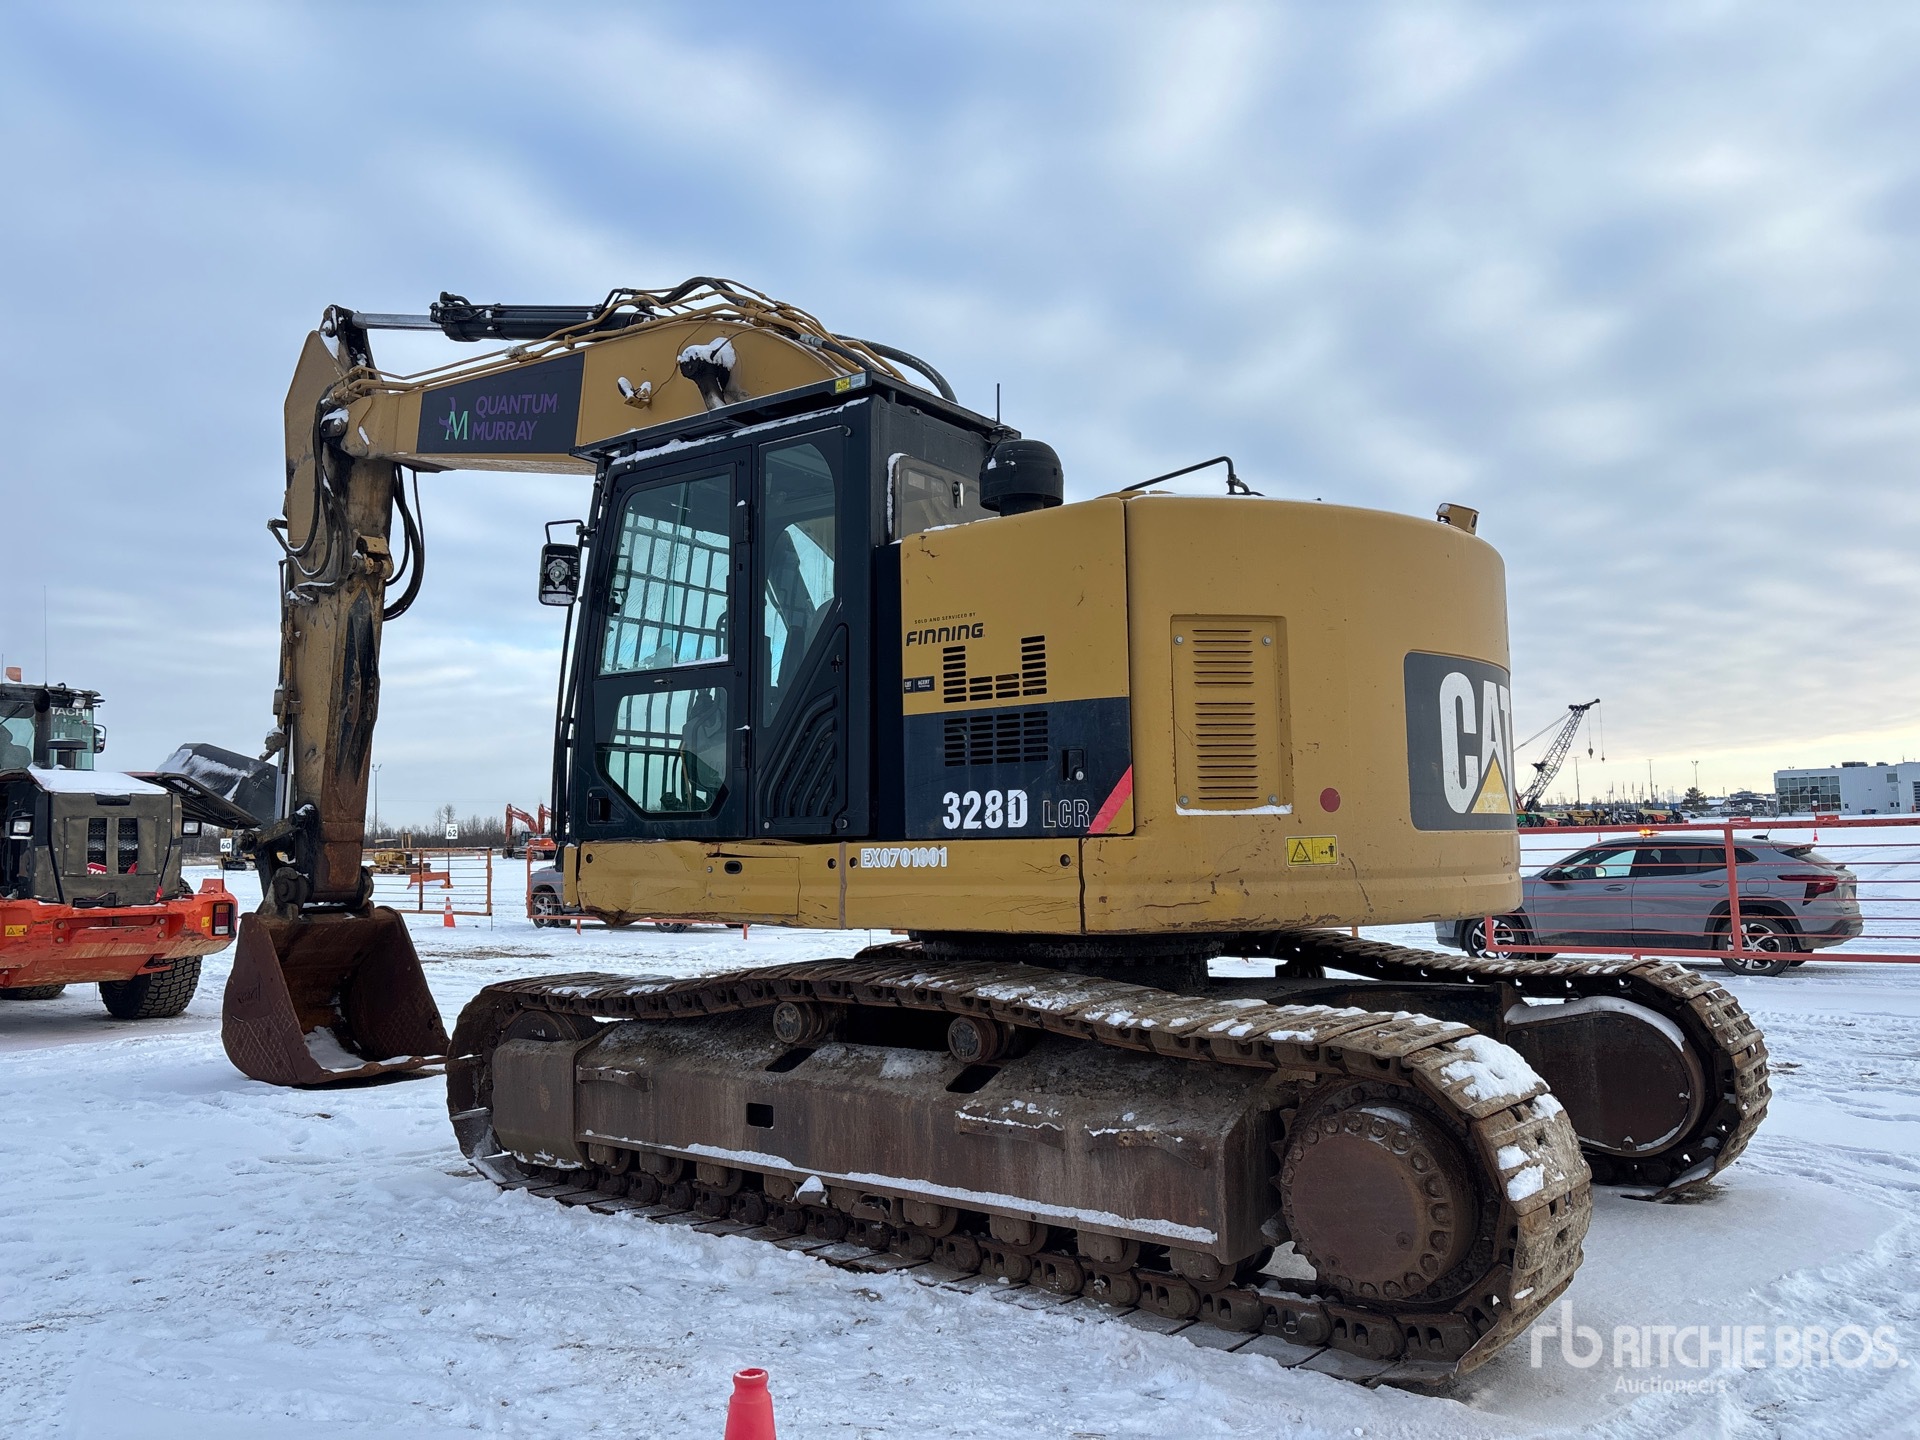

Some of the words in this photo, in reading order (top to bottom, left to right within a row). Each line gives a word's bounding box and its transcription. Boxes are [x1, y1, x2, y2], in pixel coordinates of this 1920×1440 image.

[475, 393, 558, 418] QUANTUM
[472, 420, 538, 441] MURRAY
[941, 613, 968, 621] SERVICED
[906, 622, 984, 646] FINNING
[50, 706, 89, 717] TACHI
[1439, 671, 1515, 814] CAT
[942, 789, 1028, 830] 328D
[1042, 798, 1090, 829] LCR
[447, 829, 457, 838] 62
[221, 842, 231, 850] 60
